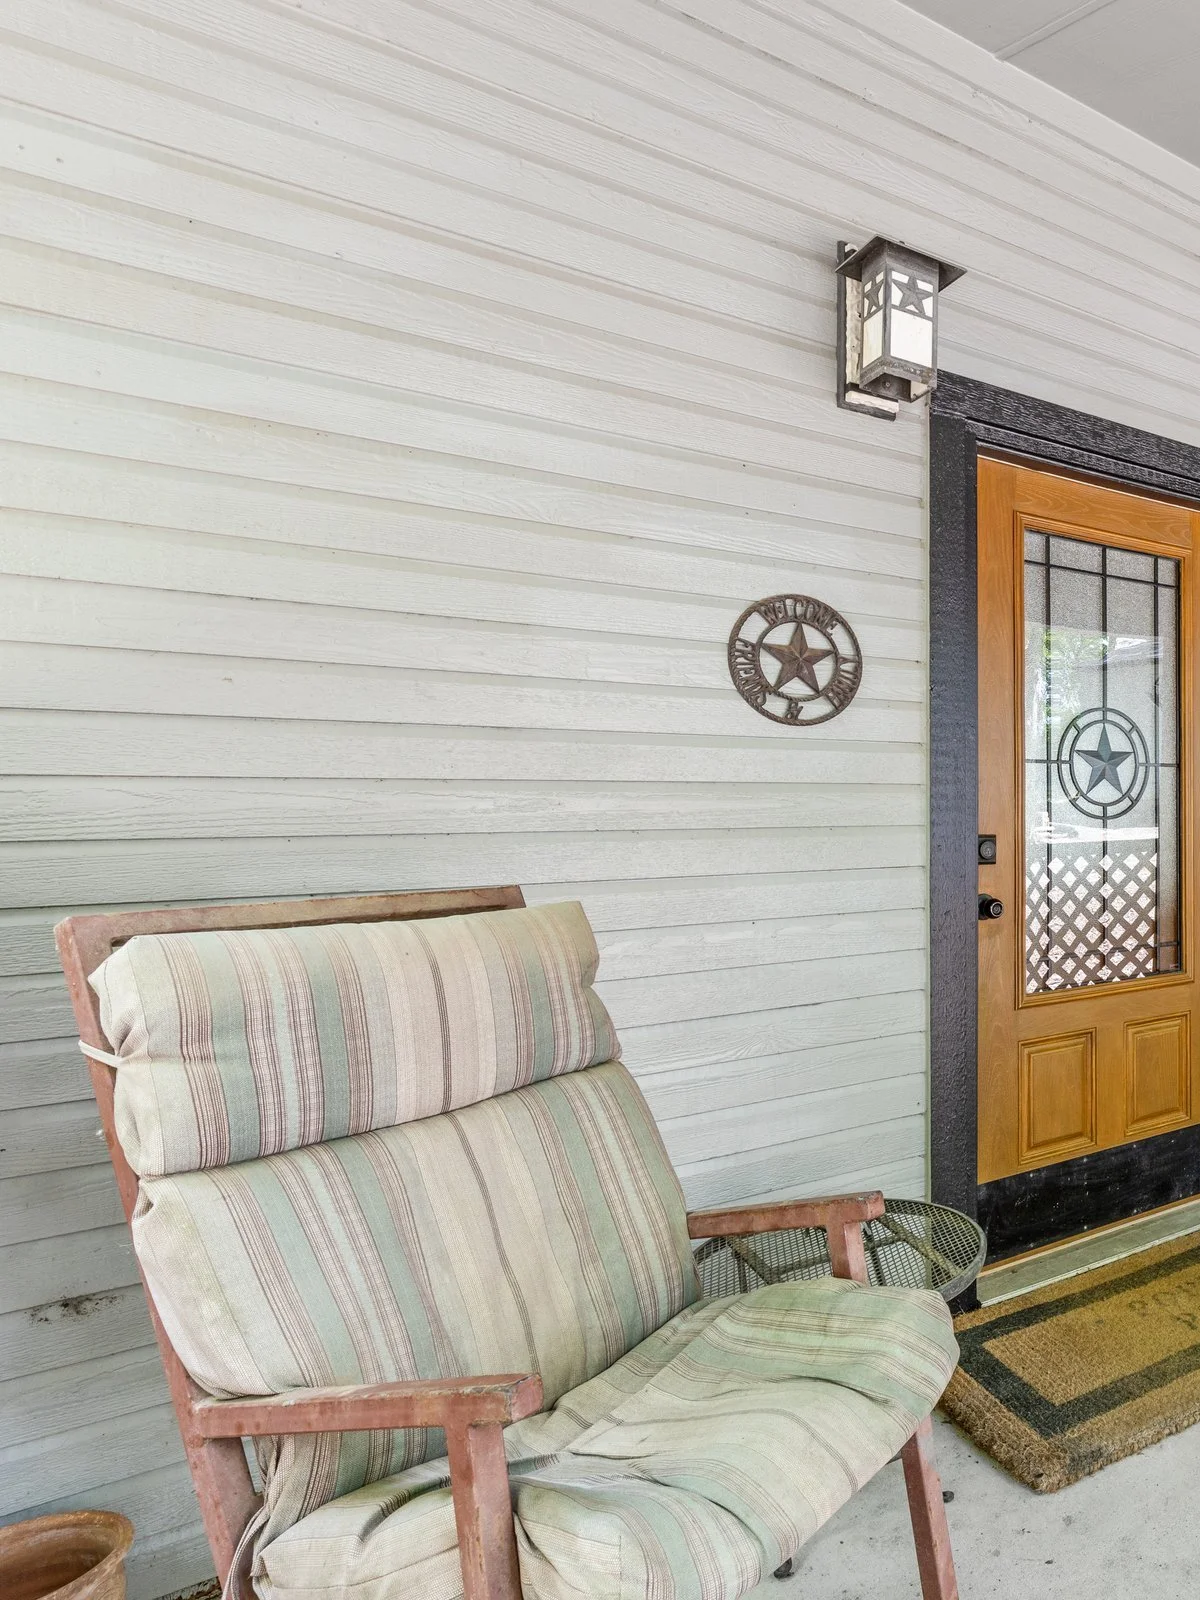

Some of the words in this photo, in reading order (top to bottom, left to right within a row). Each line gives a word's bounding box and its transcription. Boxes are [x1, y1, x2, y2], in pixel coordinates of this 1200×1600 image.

[756, 598, 841, 637] WELCOME
[731, 637, 772, 706] FRIENDS
[784, 699, 803, 720] &
[825, 655, 860, 710] FAMILY
